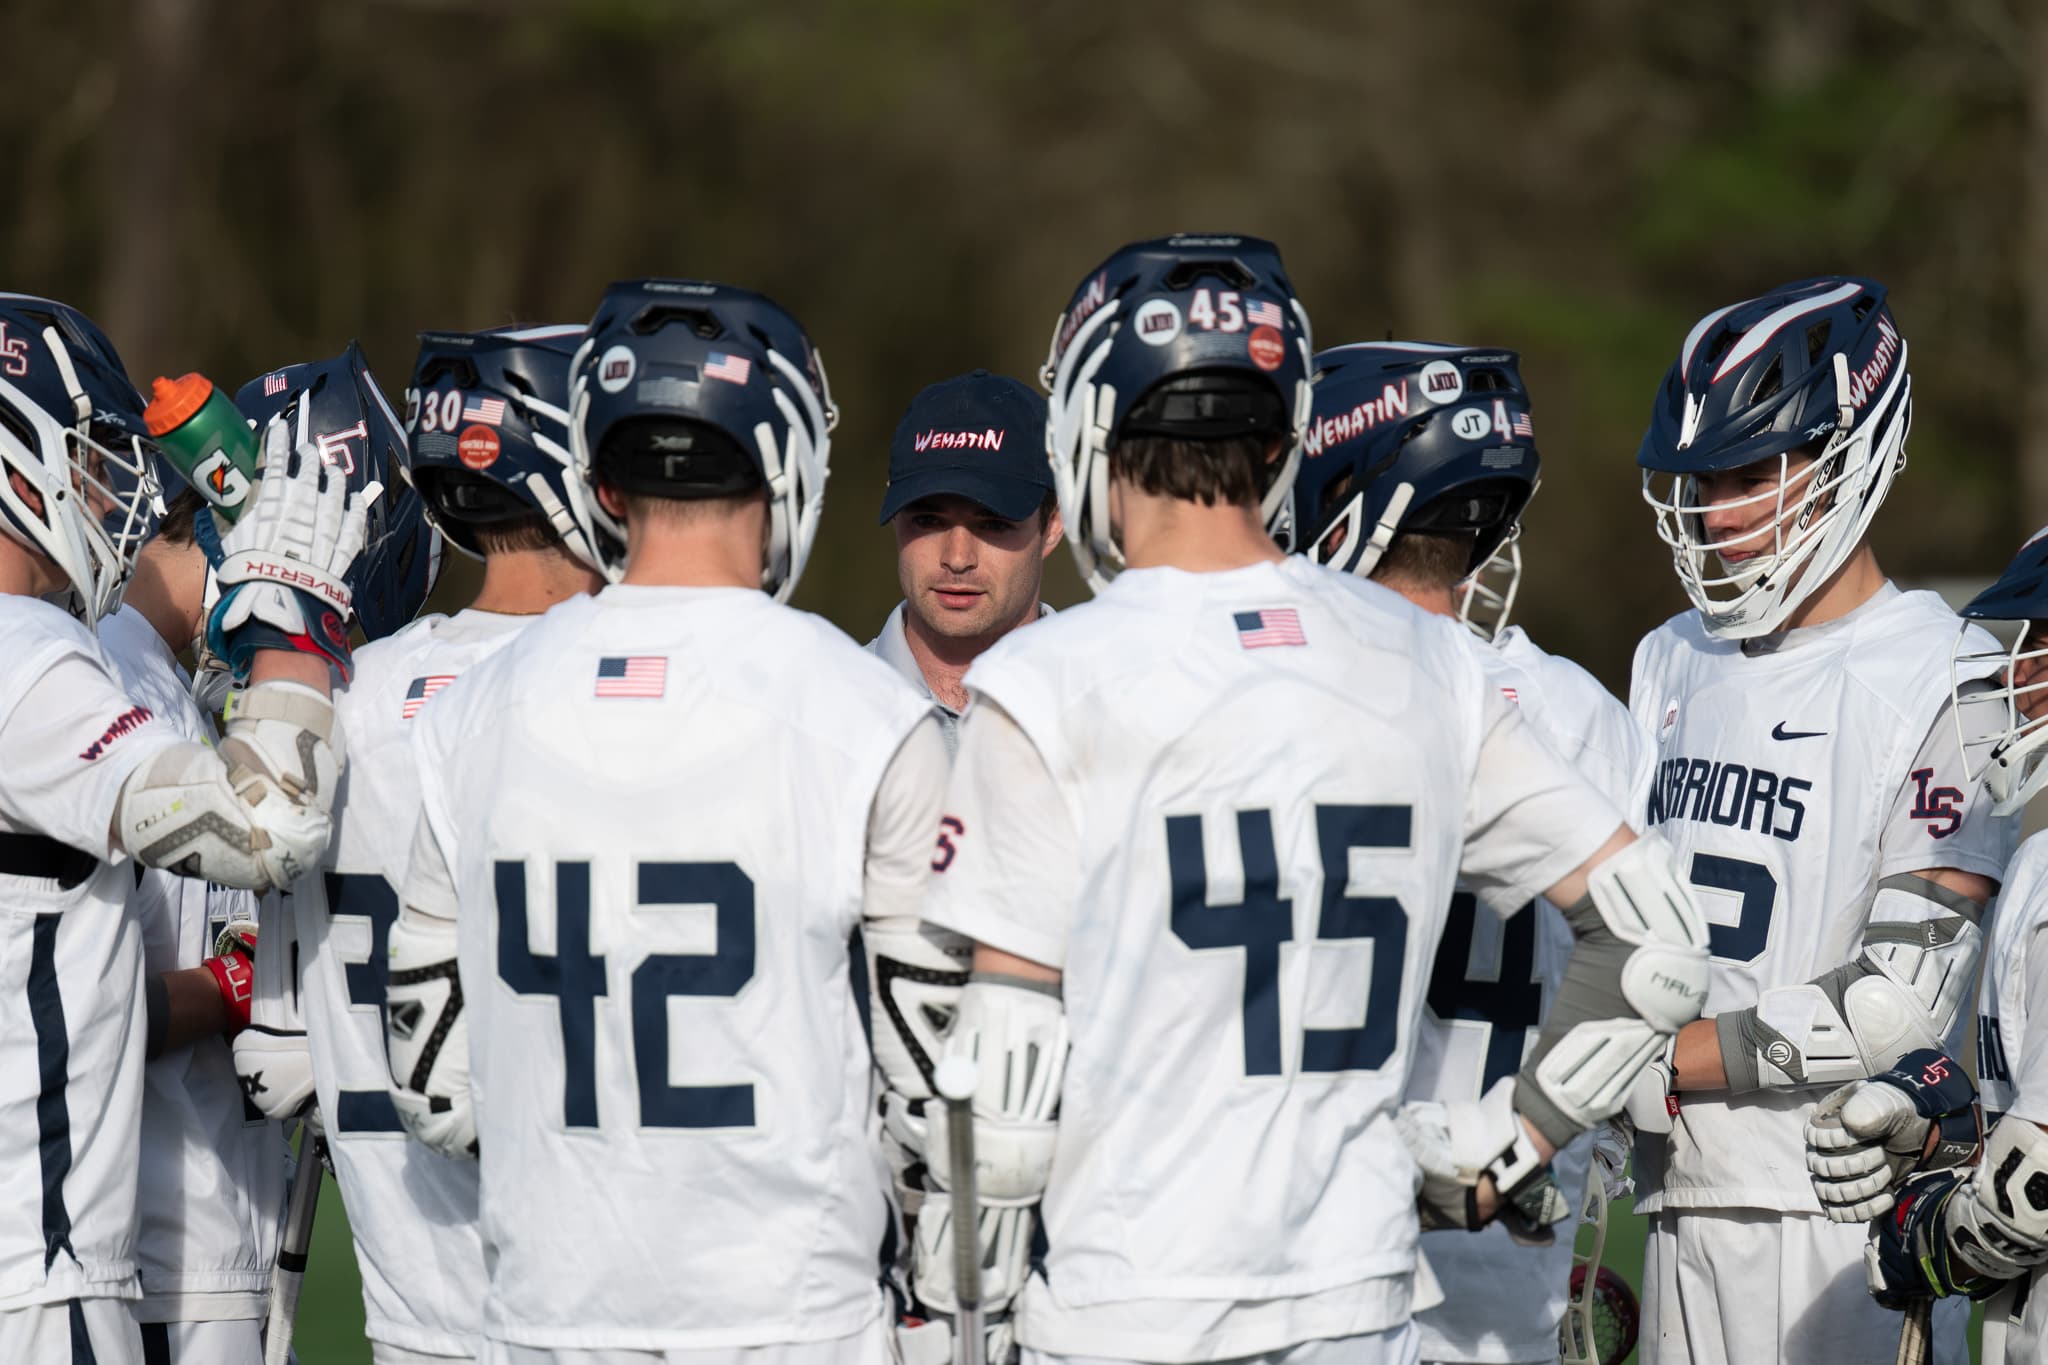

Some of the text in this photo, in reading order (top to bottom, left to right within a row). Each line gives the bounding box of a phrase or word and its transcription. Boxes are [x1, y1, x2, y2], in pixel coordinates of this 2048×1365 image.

[1189, 288, 1246, 333] 45
[1848, 312, 1900, 411] WEMATIN
[421, 389, 463, 433] 30
[913, 427, 1005, 452] WEMATIN
[1301, 376, 1410, 459] WEMATIN
[1461, 414, 1481, 434] JT
[1492, 398, 1514, 444] 4
[191, 446, 252, 508] G
[1910, 767, 1964, 840] LS
[1164, 803, 1413, 1077] 45
[493, 860, 758, 1129] 42
[1425, 890, 1542, 1101] 4
